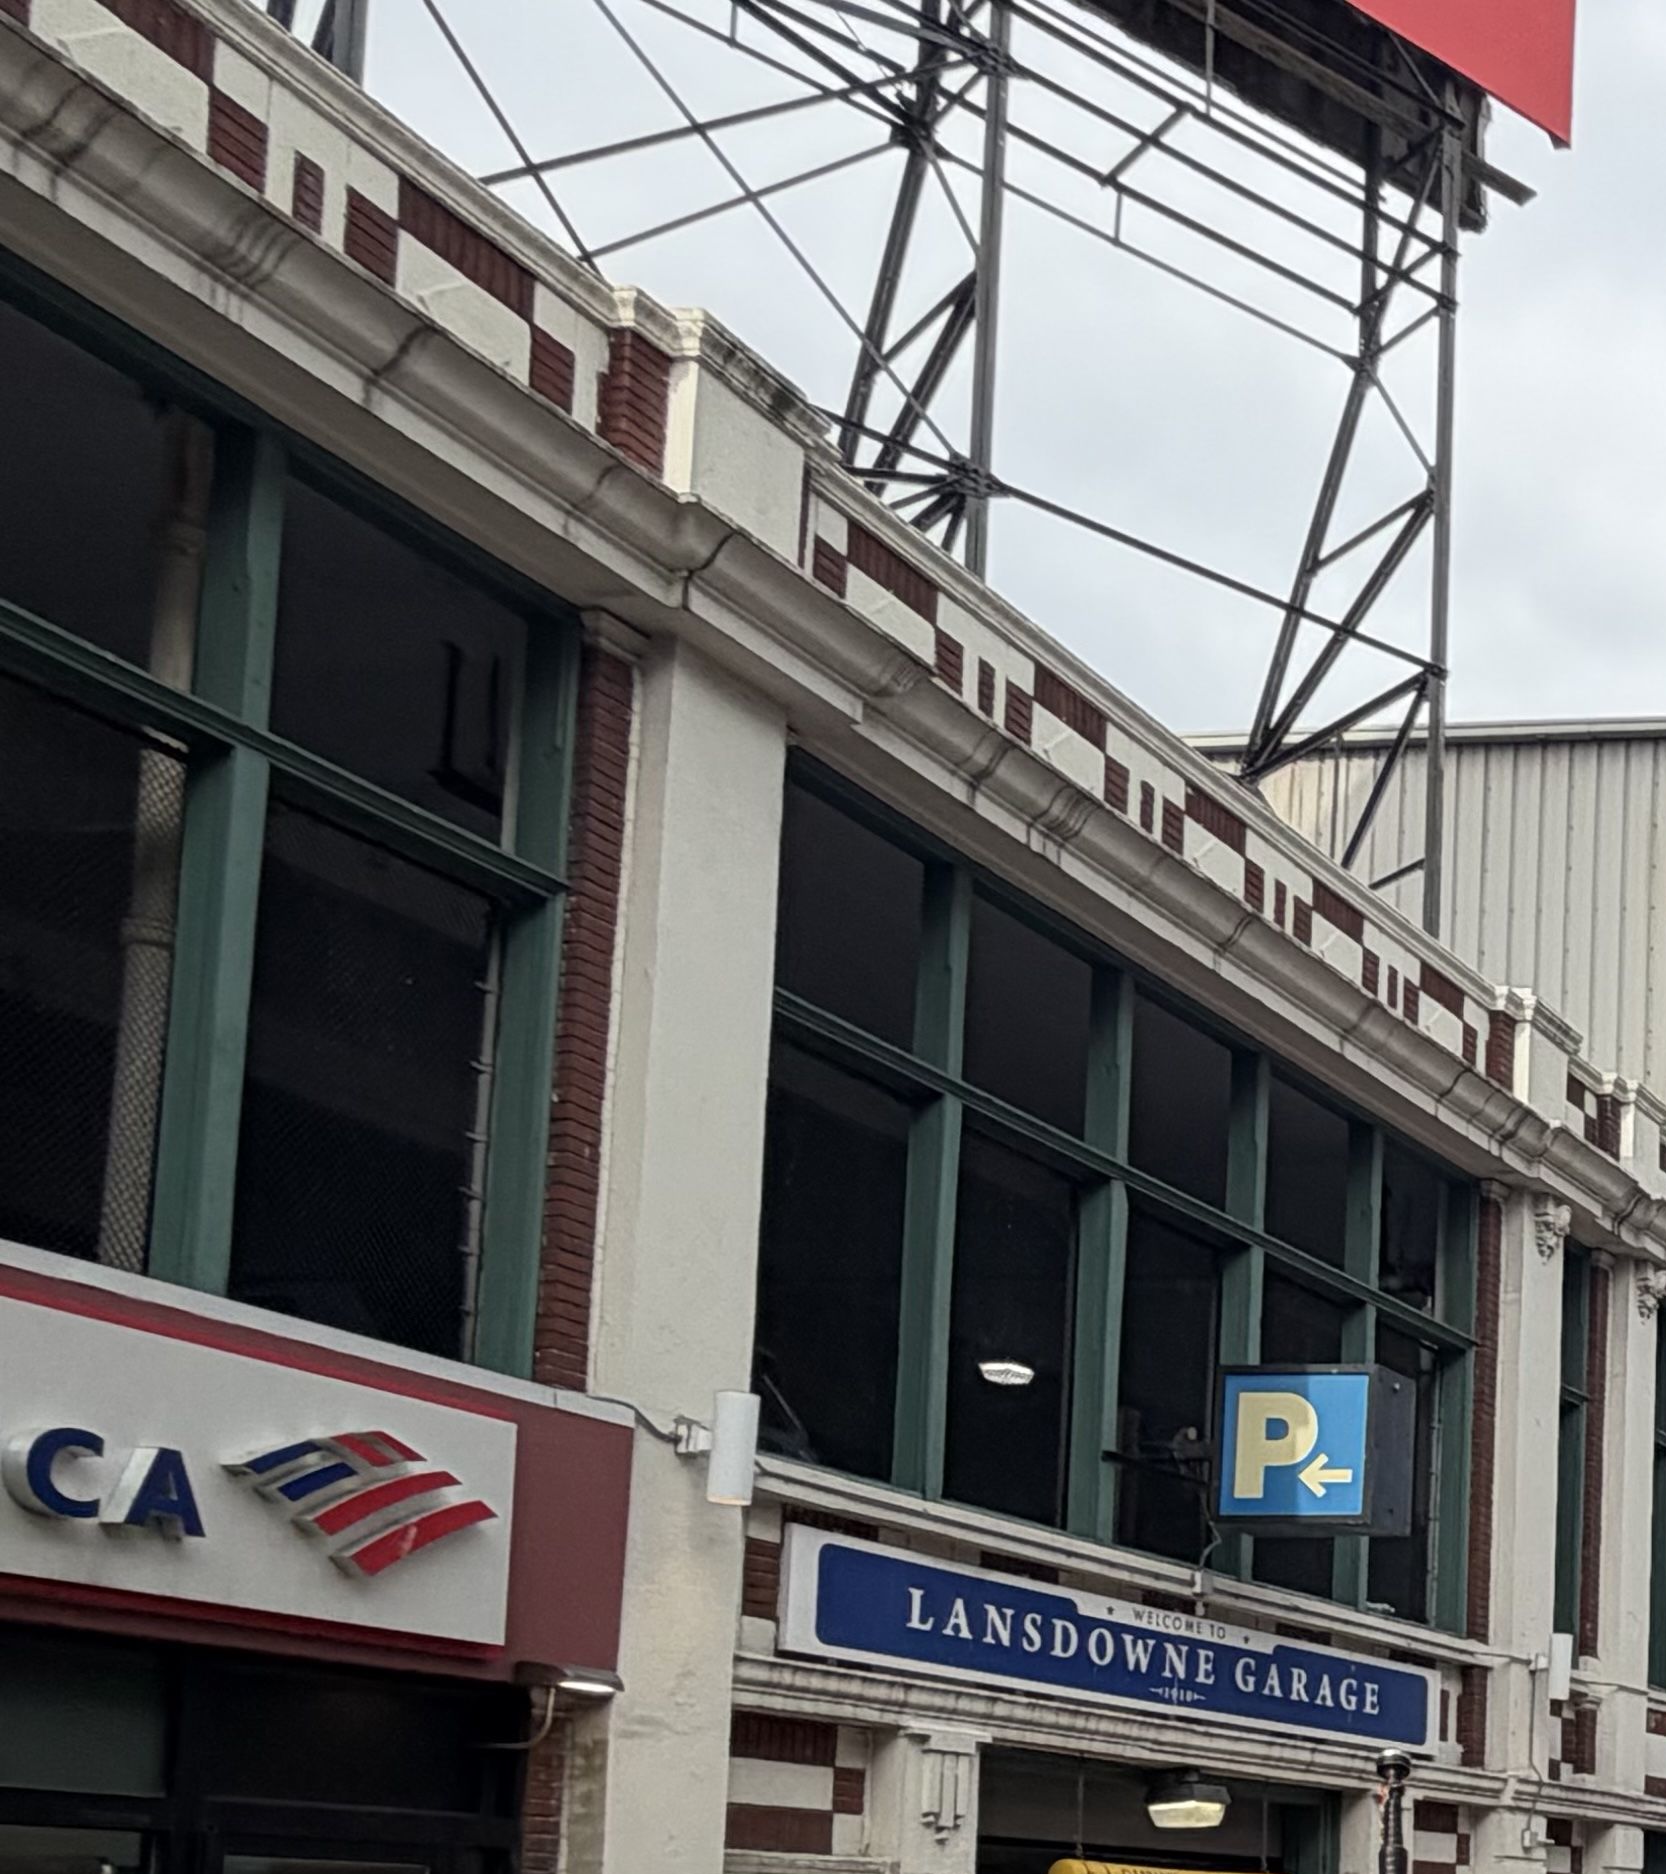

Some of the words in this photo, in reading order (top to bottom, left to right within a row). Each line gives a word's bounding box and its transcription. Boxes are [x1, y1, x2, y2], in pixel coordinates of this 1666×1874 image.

[1233, 1391, 1319, 1499] P
[906, 1586, 1216, 1685] LANSDOWNE
[1234, 1656, 1381, 1716] GARAGE
[1132, 1607, 1202, 1635] WELCOME
[1209, 1623, 1226, 1640] TO
